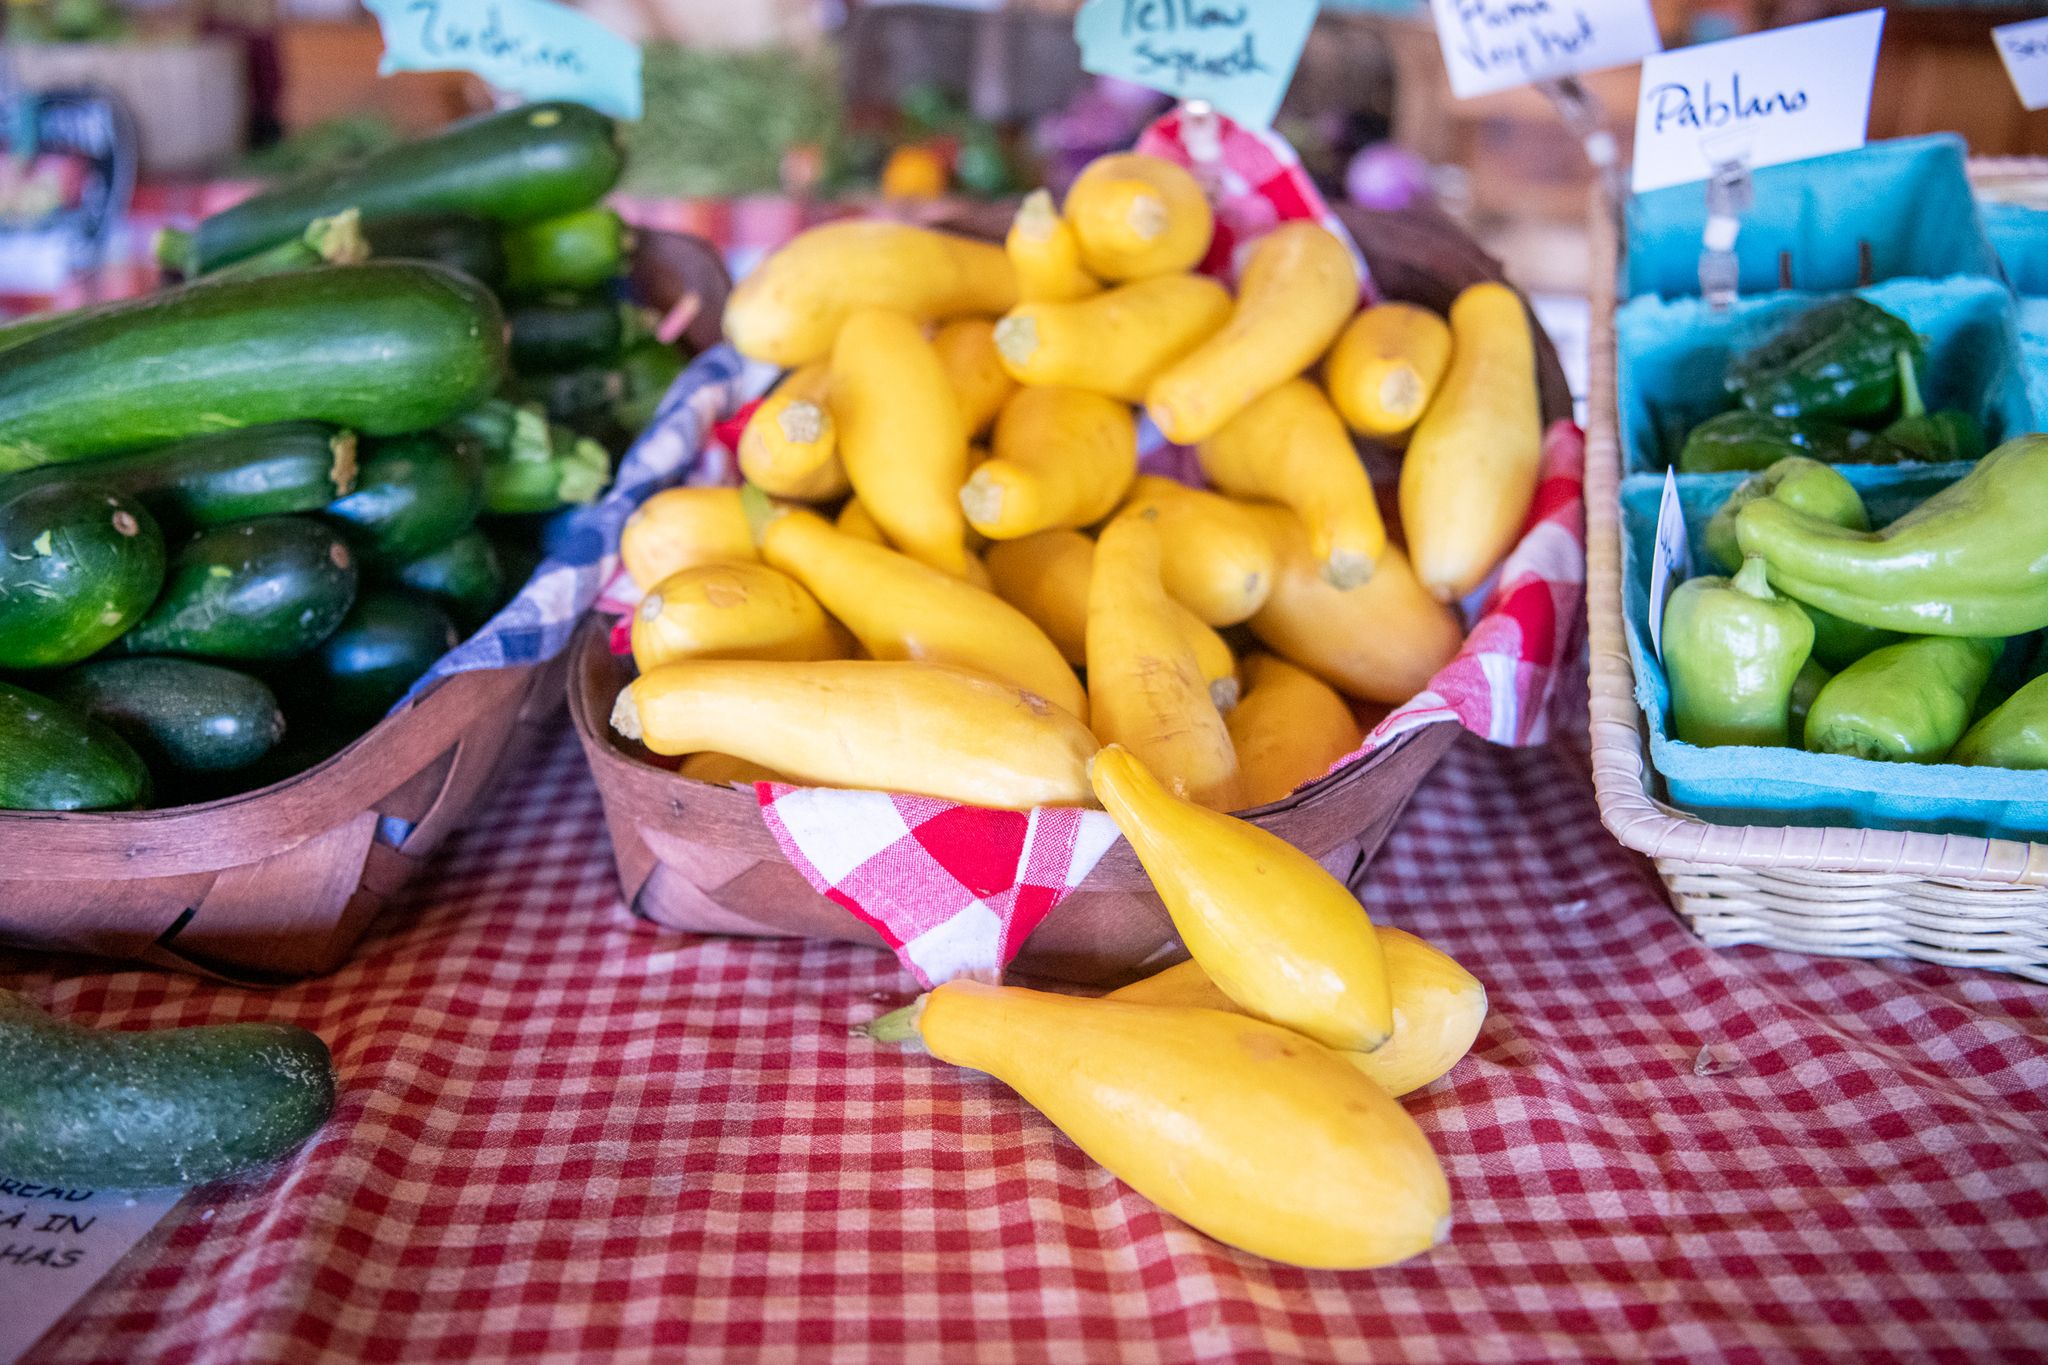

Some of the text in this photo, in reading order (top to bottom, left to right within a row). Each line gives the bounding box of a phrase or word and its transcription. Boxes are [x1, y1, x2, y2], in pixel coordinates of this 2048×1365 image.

[1647, 71, 1807, 133] Pablano
[33, 1214, 97, 1234] IN
[0, 1244, 85, 1268] HAS
